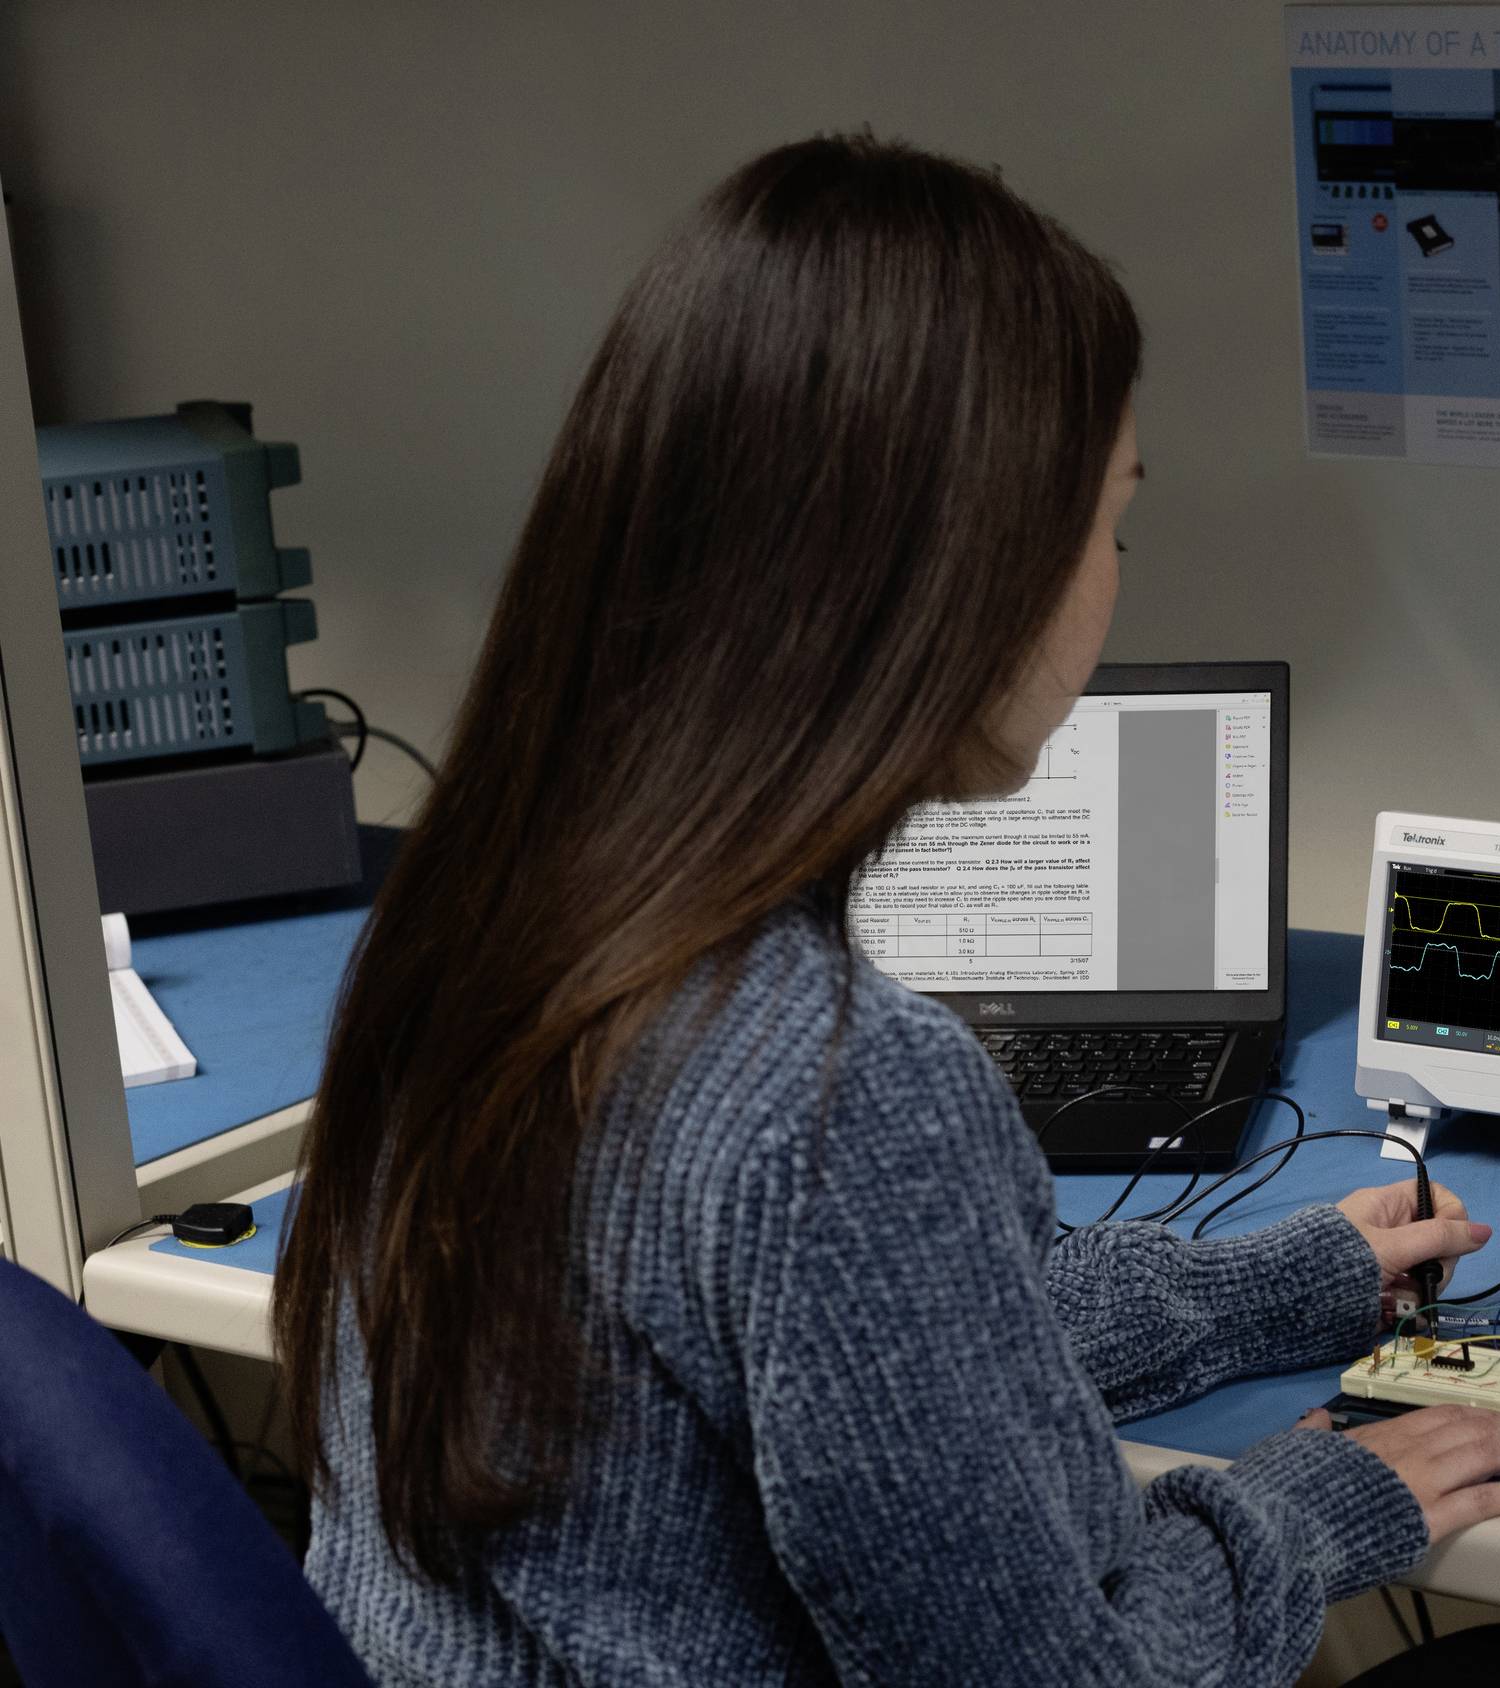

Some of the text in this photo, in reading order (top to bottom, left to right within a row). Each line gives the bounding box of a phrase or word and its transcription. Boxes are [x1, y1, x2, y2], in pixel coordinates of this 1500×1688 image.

[1299, 31, 1414, 57] ANATOMY
[1426, 31, 1460, 56] OF
[1469, 31, 1487, 57] A
[1401, 832, 1447, 846] Tektronix
[979, 1002, 1016, 1015] DELL
